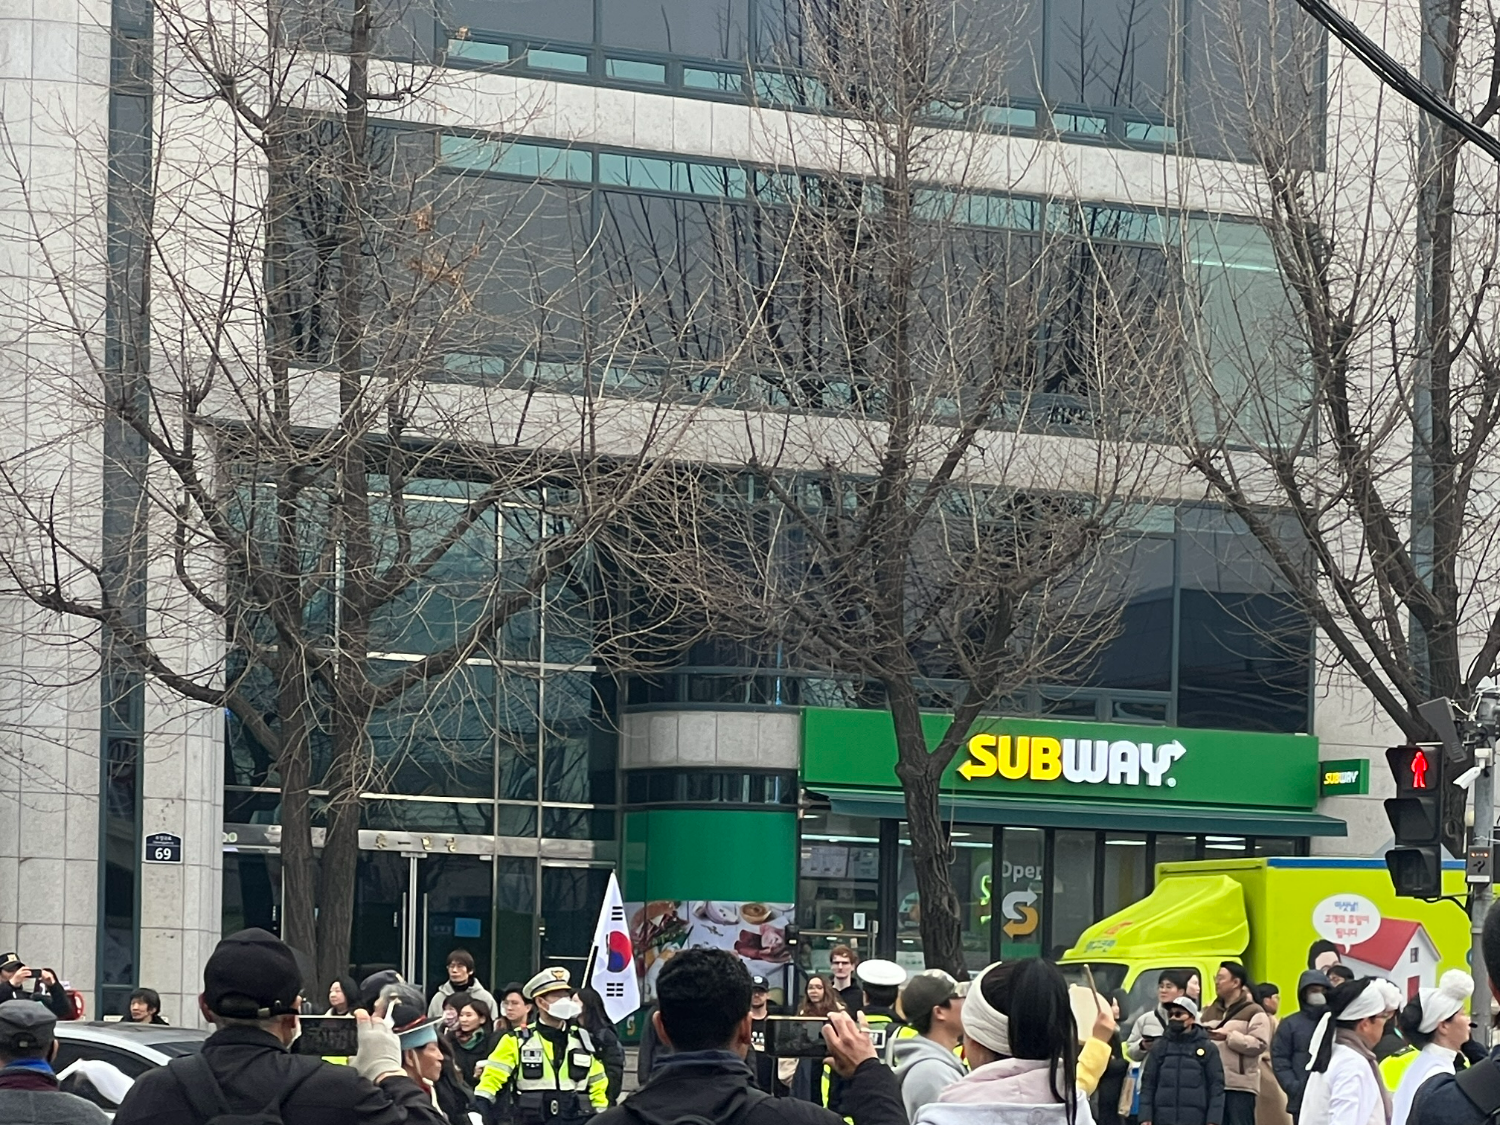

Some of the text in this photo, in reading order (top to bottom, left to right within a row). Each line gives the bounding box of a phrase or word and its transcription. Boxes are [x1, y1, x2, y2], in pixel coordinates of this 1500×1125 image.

[957, 734, 1187, 787] SUBWAY
[1323, 770, 1359, 785] SUBWAY
[155, 847, 172, 860] 69
